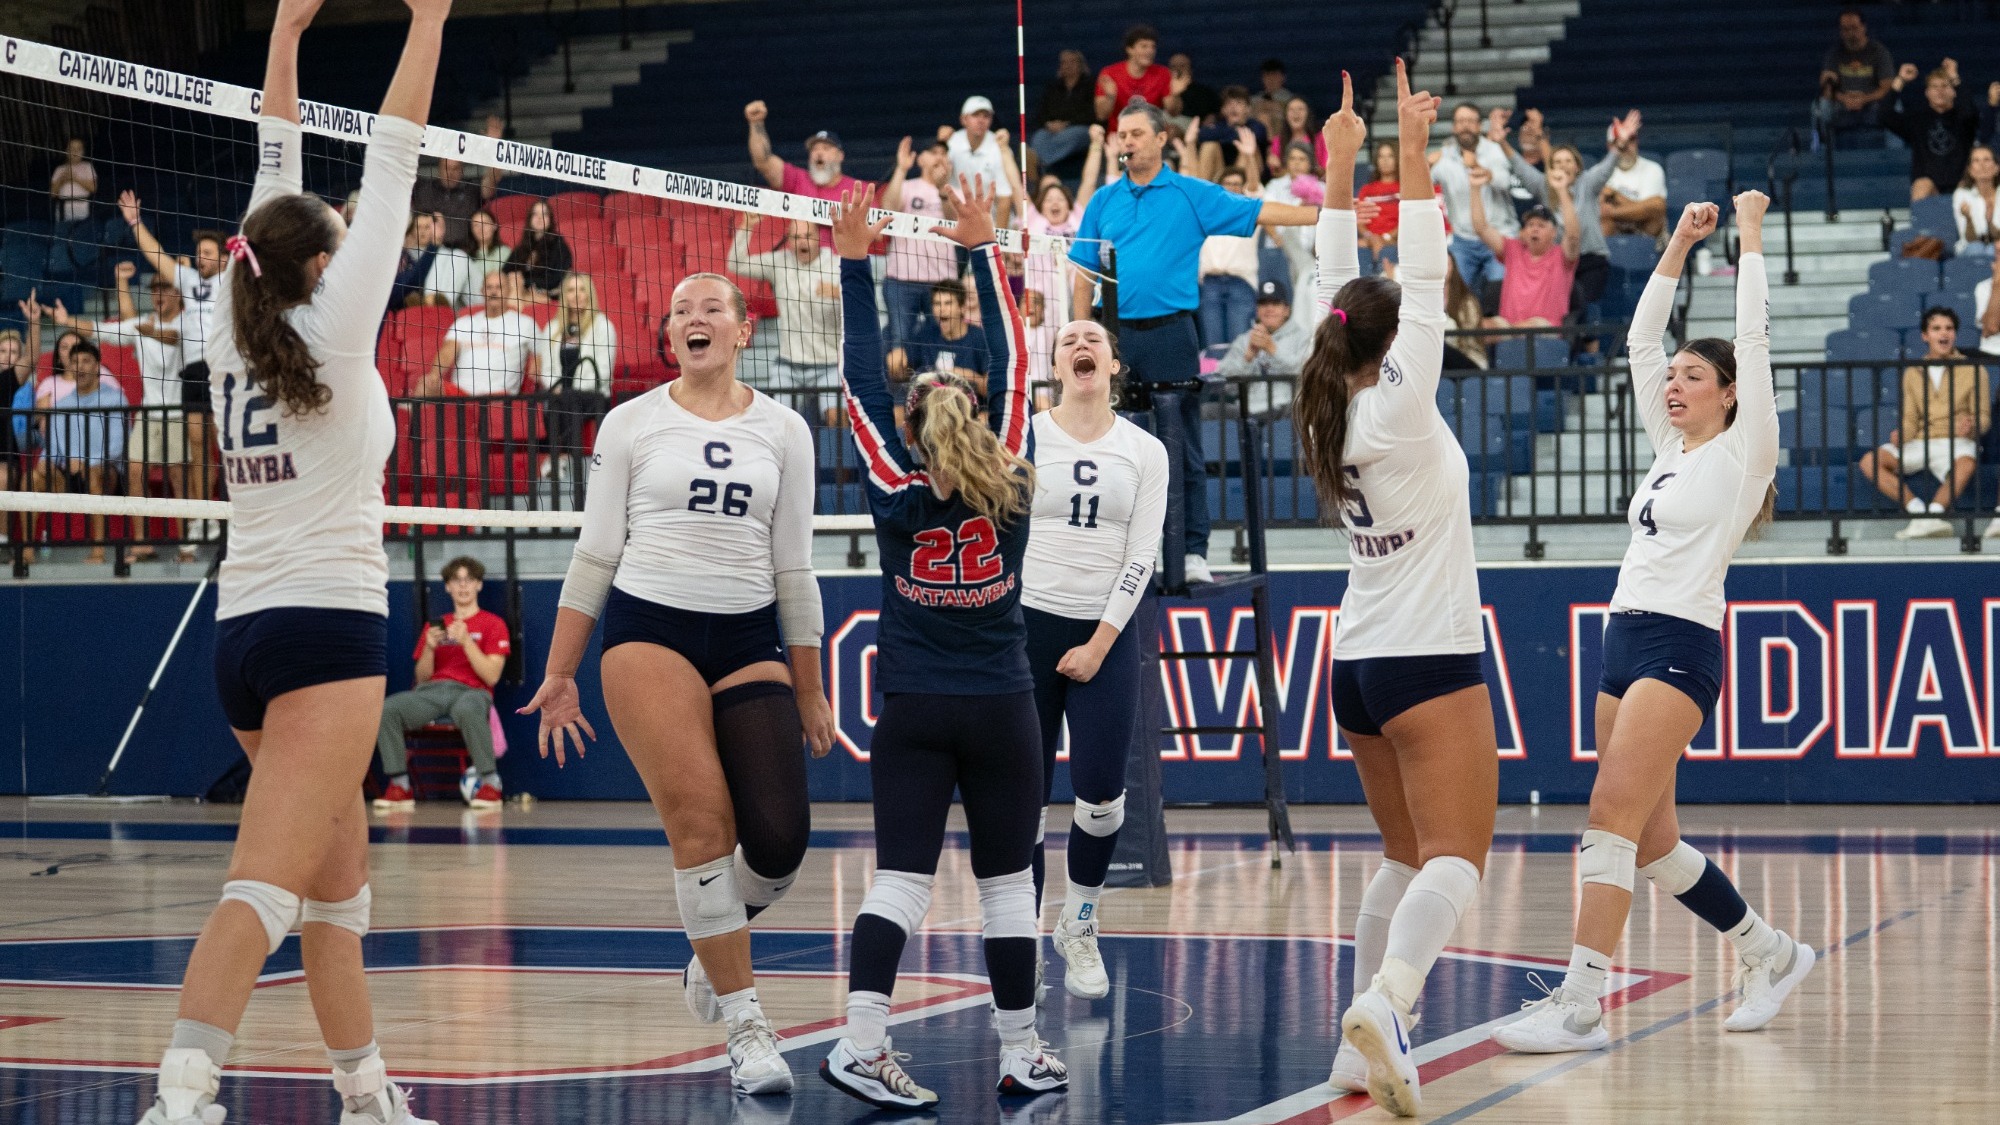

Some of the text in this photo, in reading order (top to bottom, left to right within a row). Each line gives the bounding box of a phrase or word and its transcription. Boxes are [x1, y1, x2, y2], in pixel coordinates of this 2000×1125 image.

[6, 40, 17, 64] C
[60, 51, 214, 106] CATAWBA COLLEGE
[250, 92, 262, 114] C
[458, 133, 467, 154] C
[496, 141, 607, 181] CATAWBA COLLEGE
[632, 167, 640, 186] C
[666, 173, 760, 208] CATAWBA COLLEGE
[782, 195, 790, 212] C
[704, 441, 733, 469] C
[1073, 460, 1098, 486] C
[688, 478, 753, 517] 26
[1068, 493, 1100, 529] 11
[1639, 498, 1659, 537] 4
[911, 516, 1003, 584] 22
[895, 572, 1015, 608] CATAWBA
[1119, 573, 1141, 597] LUX
